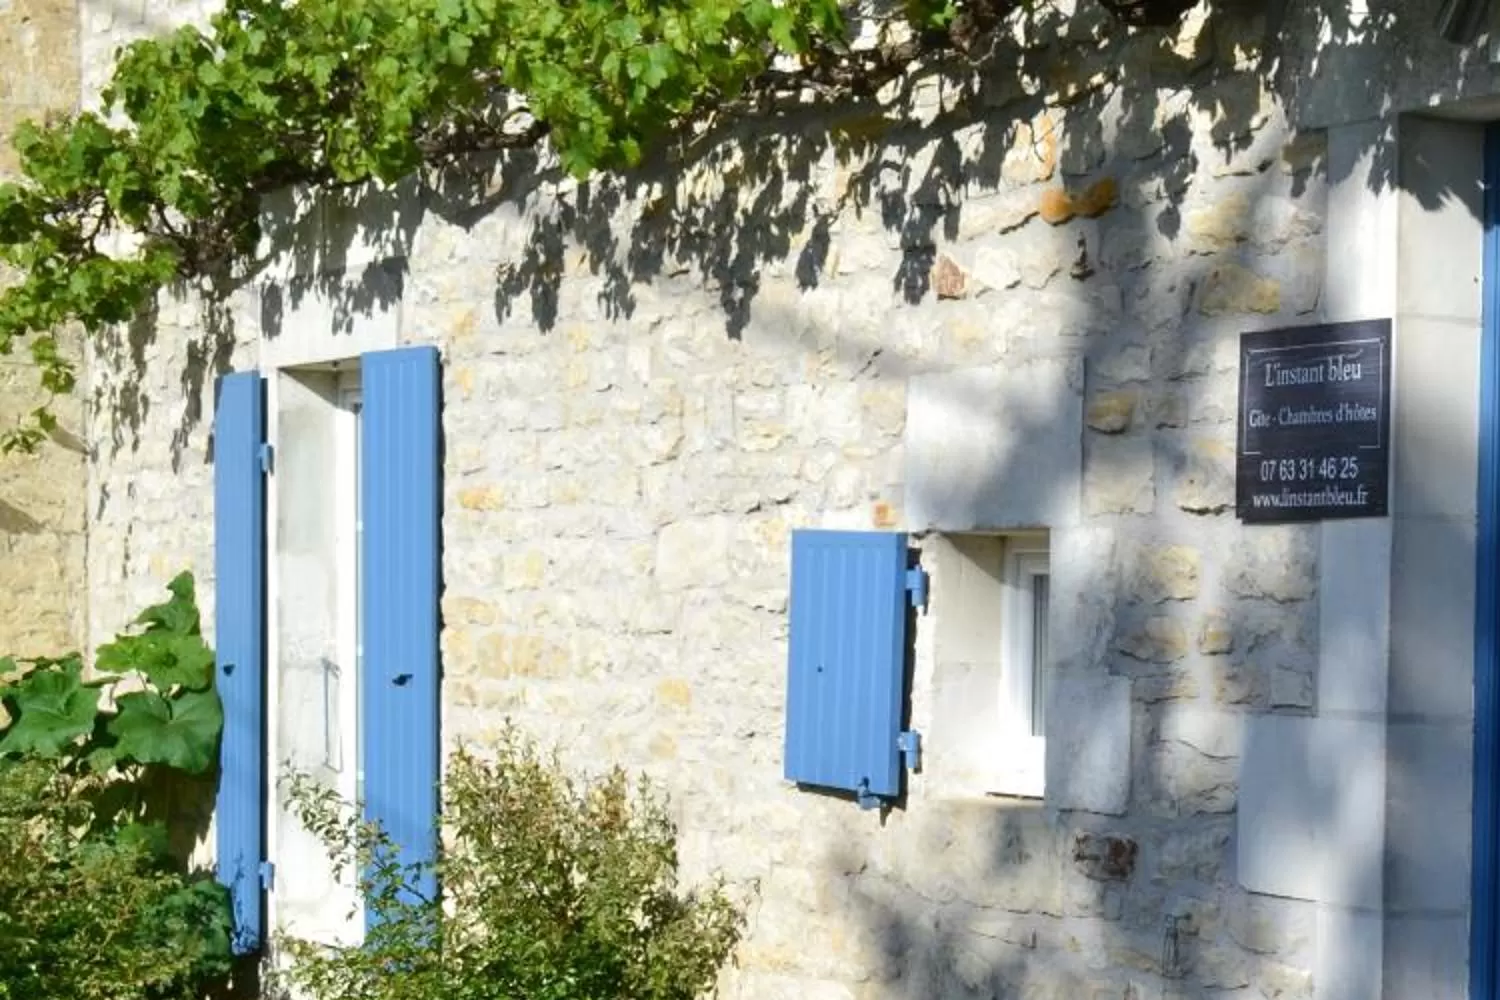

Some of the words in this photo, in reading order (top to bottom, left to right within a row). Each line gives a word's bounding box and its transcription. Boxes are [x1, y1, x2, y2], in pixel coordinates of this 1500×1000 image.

[1264, 361, 1324, 388] L'instant
[1327, 355, 1362, 382] bleu
[1260, 460, 1277, 482] 07
[1279, 458, 1296, 481] 63
[1299, 458, 1314, 480] 31
[1318, 457, 1337, 480] 46
[1339, 456, 1359, 479] 25
